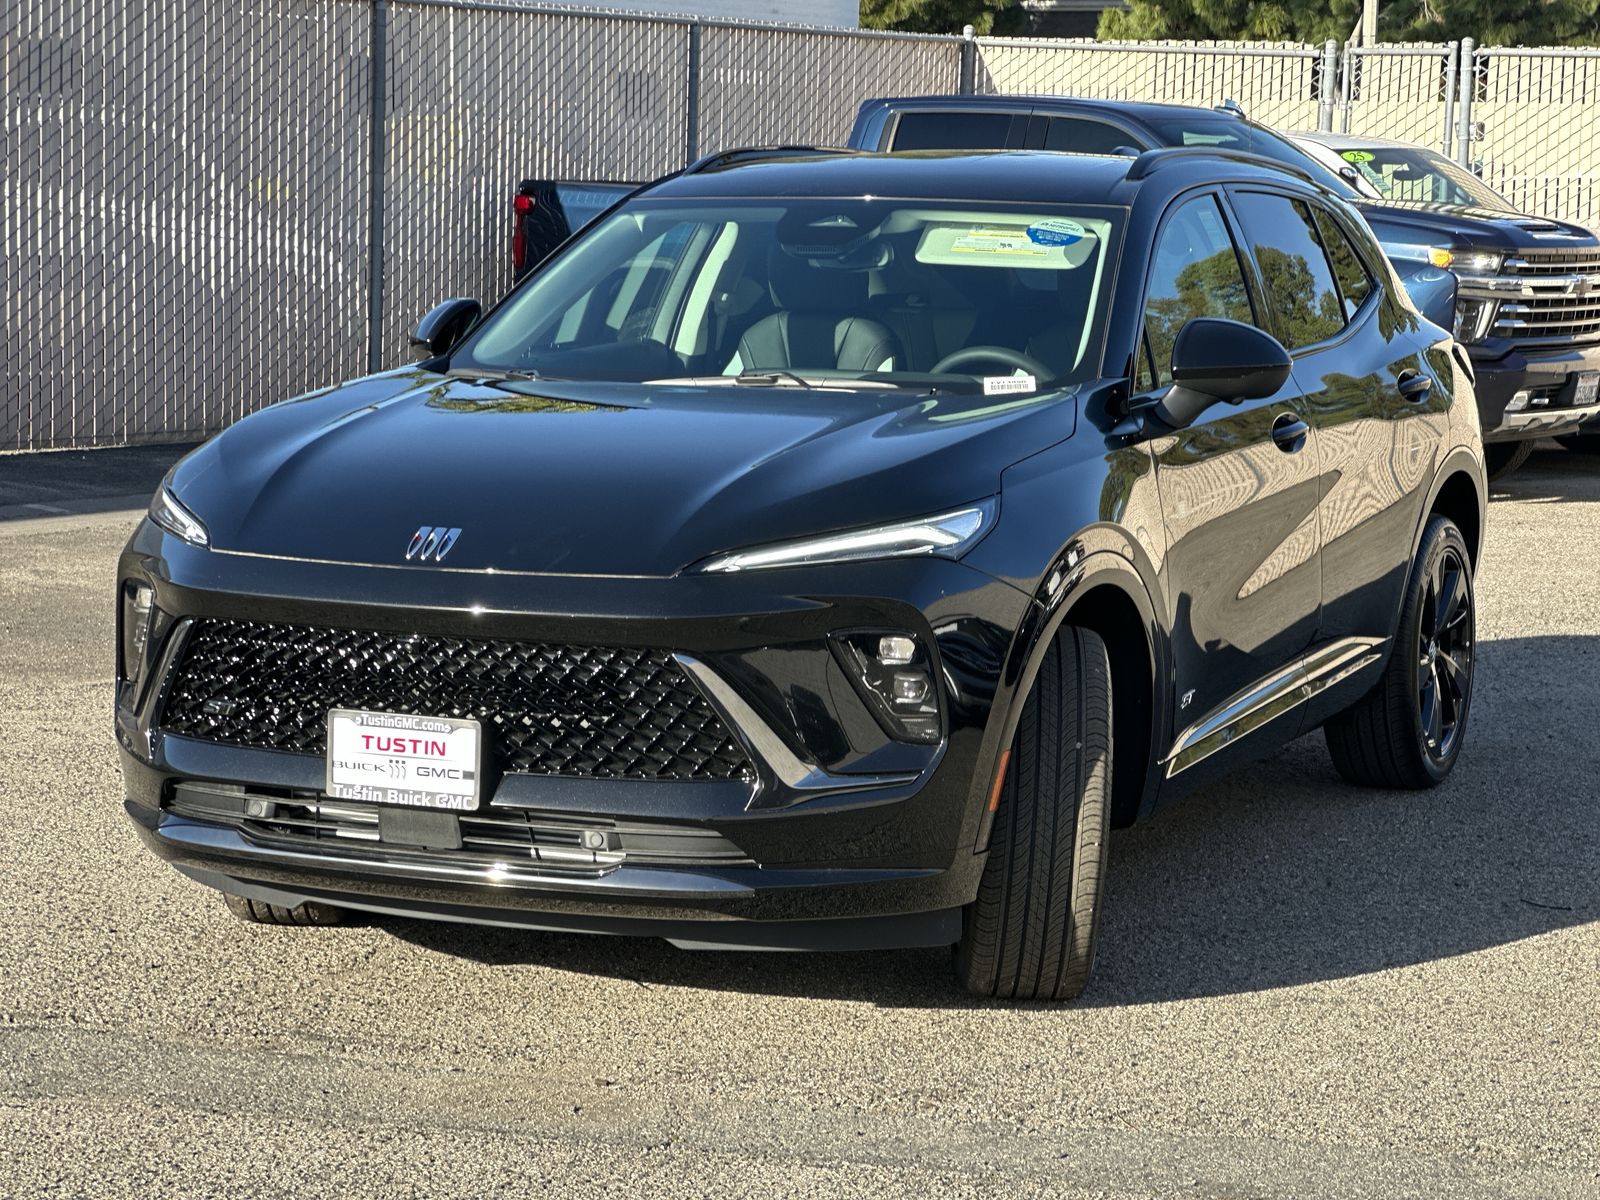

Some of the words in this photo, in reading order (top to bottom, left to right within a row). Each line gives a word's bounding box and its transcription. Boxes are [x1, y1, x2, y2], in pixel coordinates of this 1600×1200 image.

[1349, 151, 1365, 161] 25
[360, 713, 446, 732] TustinGMC.com
[361, 735, 446, 756] TUSTIN
[332, 760, 386, 773] BUICK
[416, 766, 460, 780] GMC
[333, 783, 383, 803] Tustin
[386, 789, 432, 808] Buick
[435, 793, 474, 811] GMC
